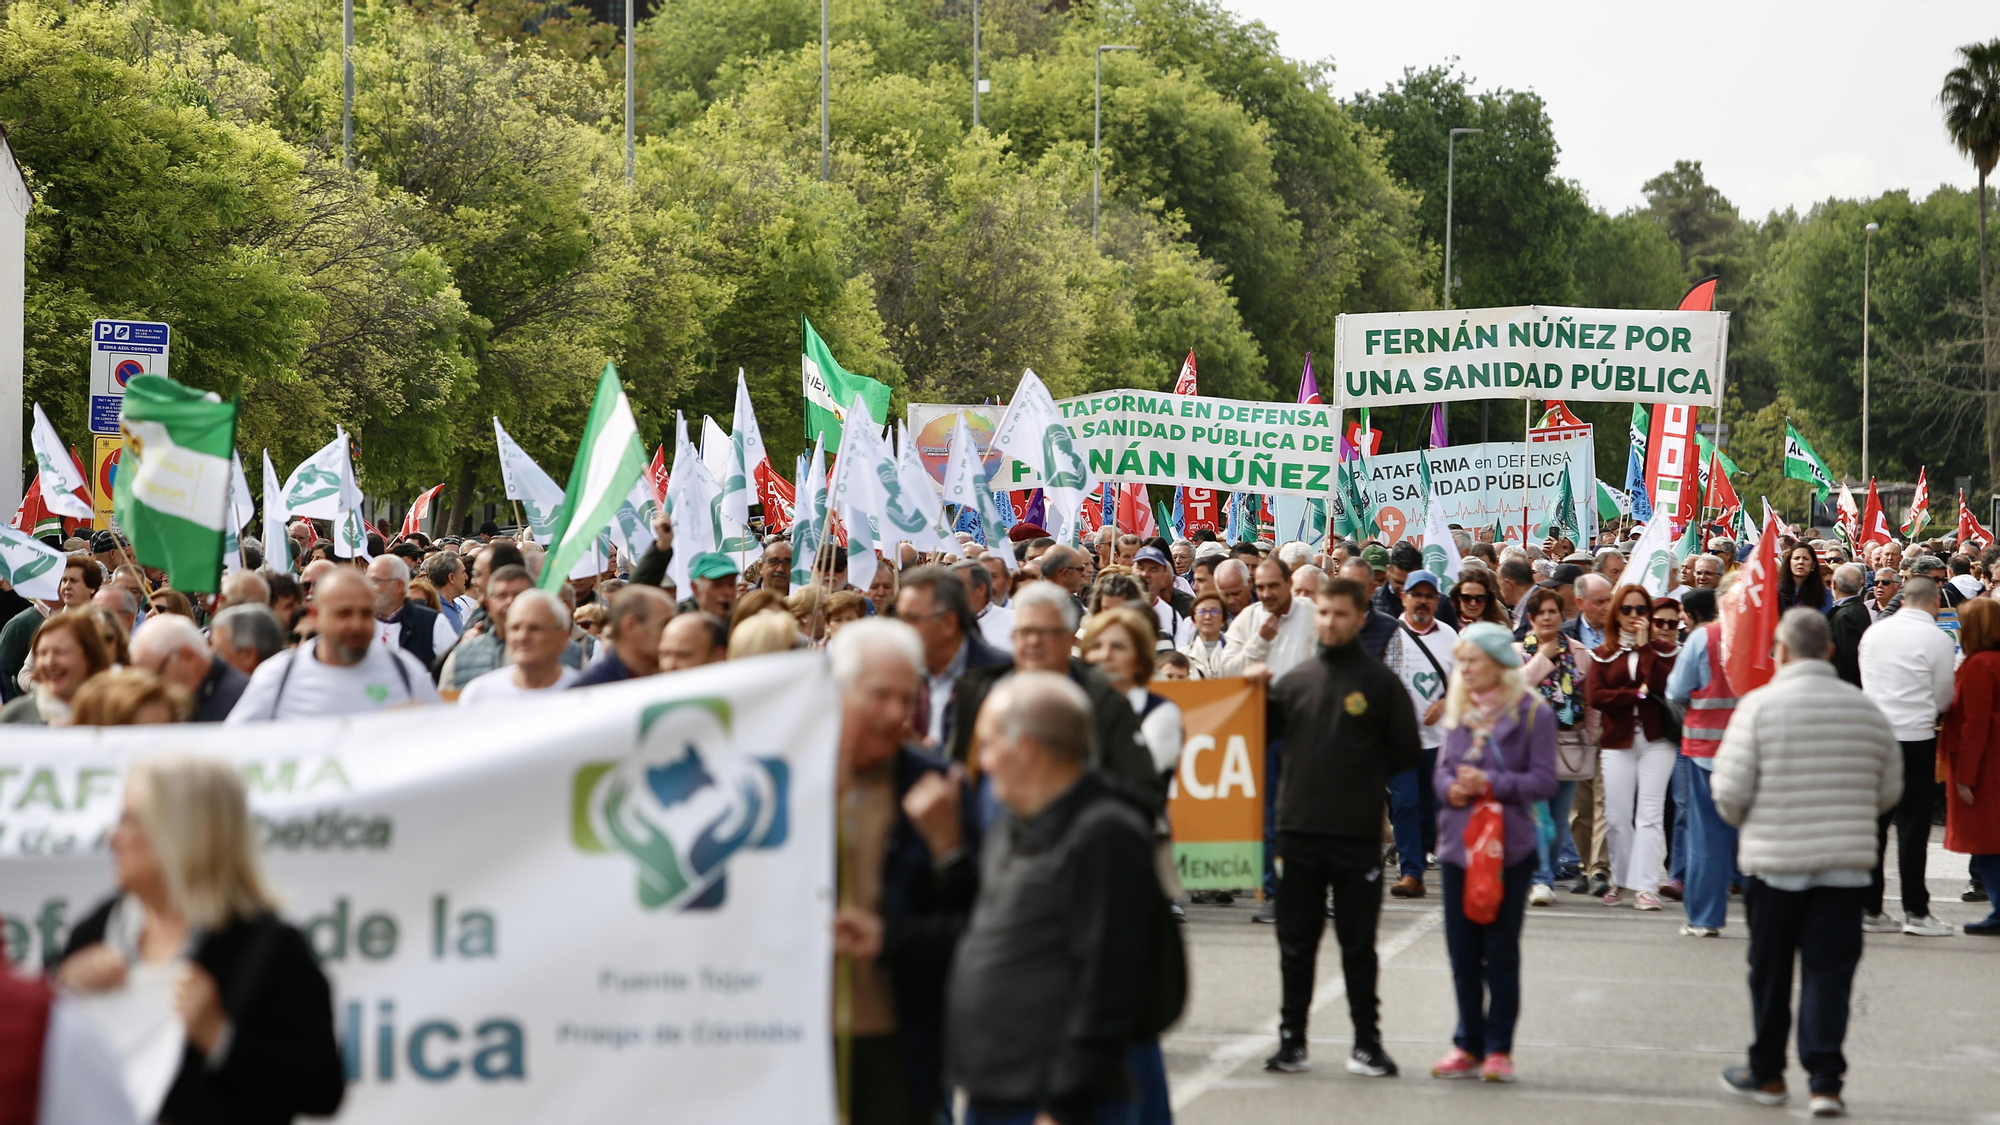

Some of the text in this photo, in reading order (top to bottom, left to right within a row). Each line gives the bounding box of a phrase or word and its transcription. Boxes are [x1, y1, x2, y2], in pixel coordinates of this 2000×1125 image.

[100, 324, 113, 339] P
[1365, 315, 1693, 356] FERNÁN NÚÑEZ POR
[1345, 358, 1713, 397] UNA SANIDAD PÚBLICA
[1058, 395, 1174, 419] TAFORMA
[1181, 401, 1212, 419] EN
[1218, 405, 1329, 428] DEFENSA
[1082, 420, 1186, 441] SANIDAD
[1192, 423, 1296, 450] PÚBLICA
[1303, 434, 1334, 452] DE
[1012, 441, 1331, 492] FNÁN NÚÑEZ
[1475, 457, 1492, 469] en
[1498, 451, 1572, 468] DEFENSA
[1375, 490, 1387, 504] la
[1392, 476, 1481, 501] SAIDAD
[305, 892, 498, 964] de la
[342, 998, 530, 1083] lica
